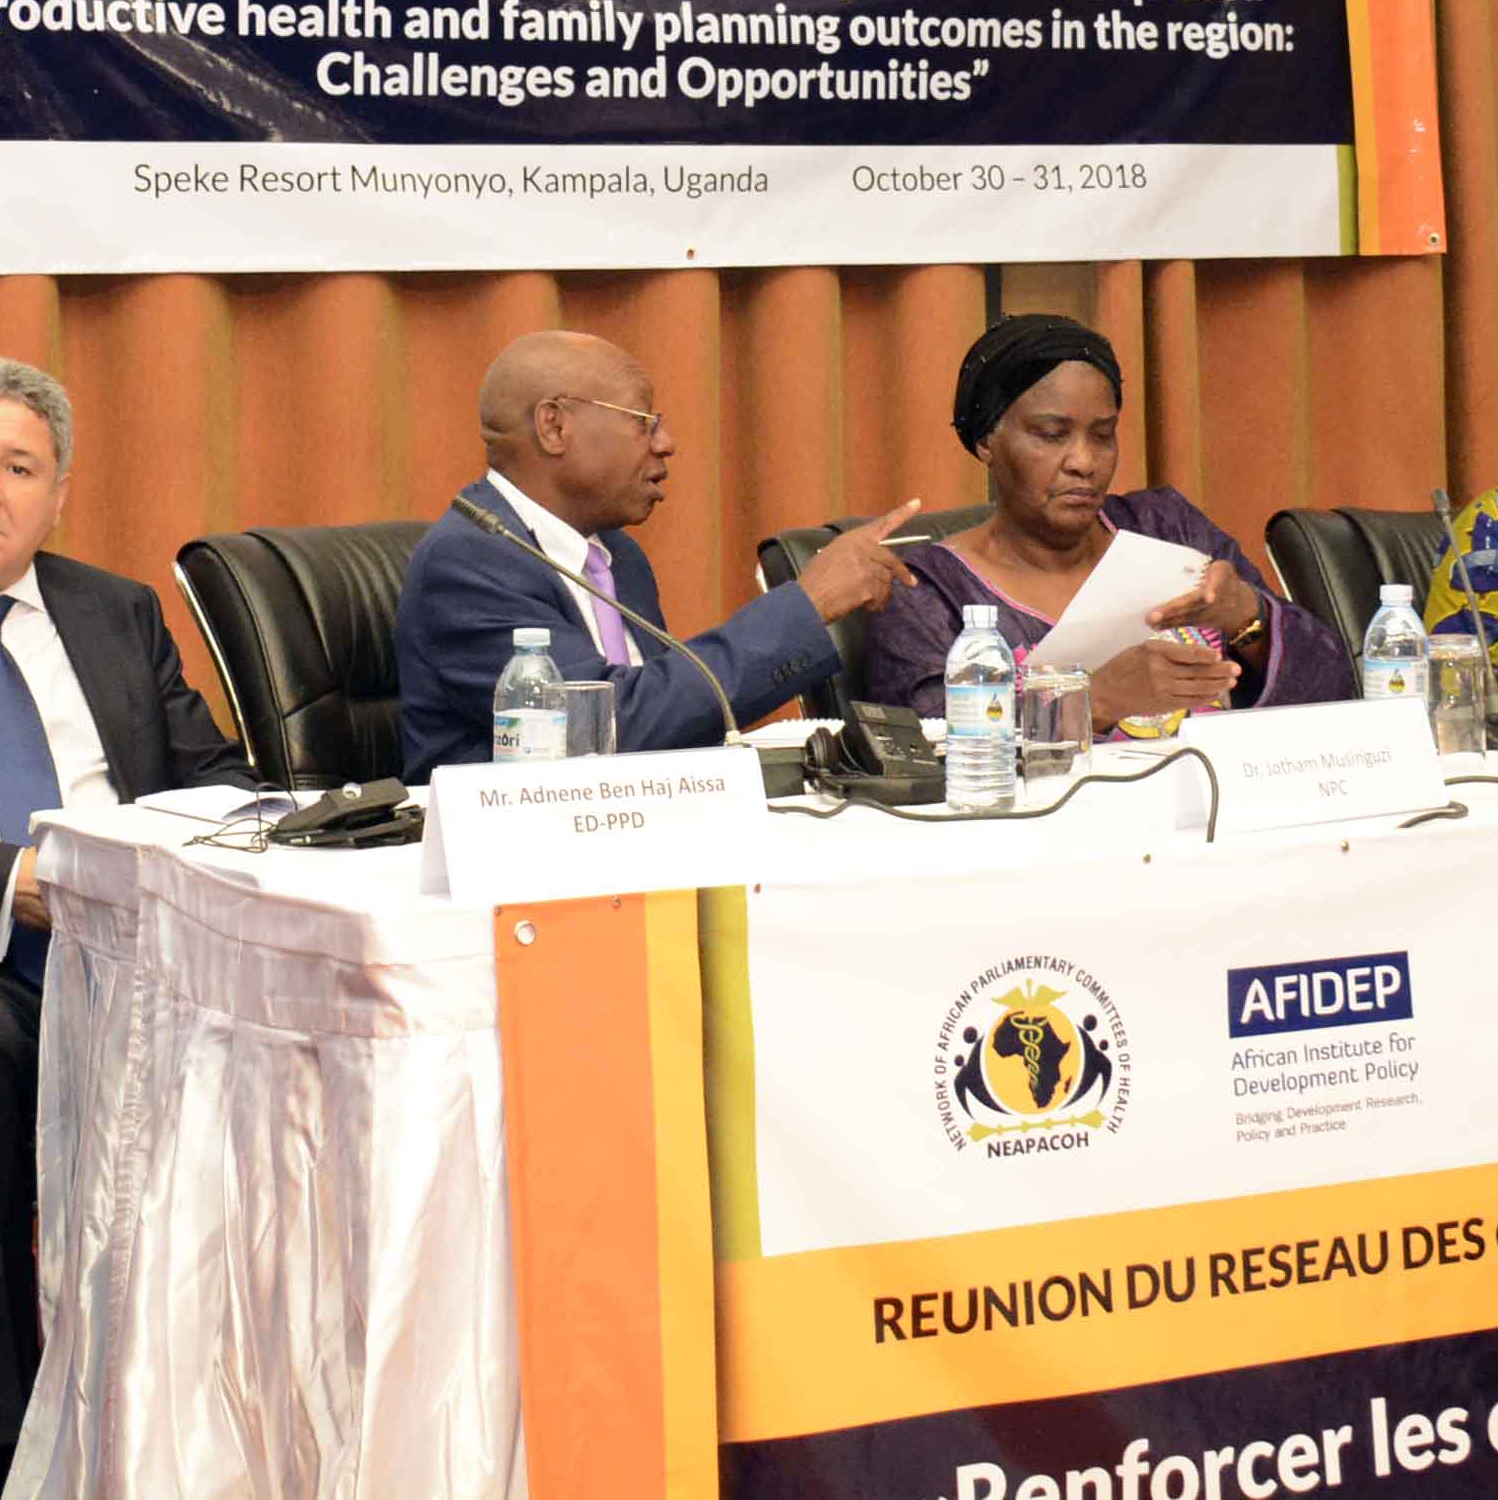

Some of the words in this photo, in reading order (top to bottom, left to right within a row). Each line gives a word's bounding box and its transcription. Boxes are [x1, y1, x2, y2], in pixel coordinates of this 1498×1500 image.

[654, 1, 840, 54] planning
[850, 10, 1042, 48] outcomes
[1052, 9, 1085, 48] in
[1094, 10, 1158, 49] the
[1168, 12, 1293, 58] region:
[317, 51, 574, 106] Challenges
[586, 56, 666, 98] and
[678, 57, 989, 107] Opportunities”
[135, 164, 228, 198] Speke
[240, 164, 341, 192] Resort
[351, 165, 513, 199] Munyonyo,
[523, 166, 654, 198] Kampala,
[664, 165, 768, 199] Uganda
[853, 165, 962, 191] October
[972, 165, 1004, 190] 30
[1034, 164, 1072, 191] 31,
[1080, 164, 1147, 188] 2018
[1242, 761, 1262, 778] Dr.
[1266, 755, 1318, 776] Jotham
[1325, 746, 1393, 774] Musinguzi
[480, 790, 512, 807] Mr.
[520, 786, 592, 804] Adnene
[600, 782, 635, 799] Ben
[642, 778, 672, 799] Haj
[679, 776, 725, 793] Aissa
[1318, 780, 1347, 796] NPC
[574, 812, 644, 832] ED-PPD
[1241, 966, 1400, 1023] AFIDEP
[1232, 1049, 1297, 1070] African
[1304, 1040, 1382, 1062] Institute
[1389, 1032, 1415, 1052] for
[1234, 1068, 1358, 1096] Development
[1365, 1060, 1418, 1081] Policy
[1236, 1111, 1283, 1125] Bridging
[1287, 1100, 1362, 1119] Development
[1366, 1092, 1421, 1108] Research,
[988, 1132, 1088, 1158] NEAPACOH
[874, 1269, 1113, 1343] REUNION
[1127, 1257, 1195, 1309] DU
[1210, 1231, 1388, 1297] RESEAU
[1403, 1218, 1485, 1269] DES
[1371, 1397, 1470, 1476] les
